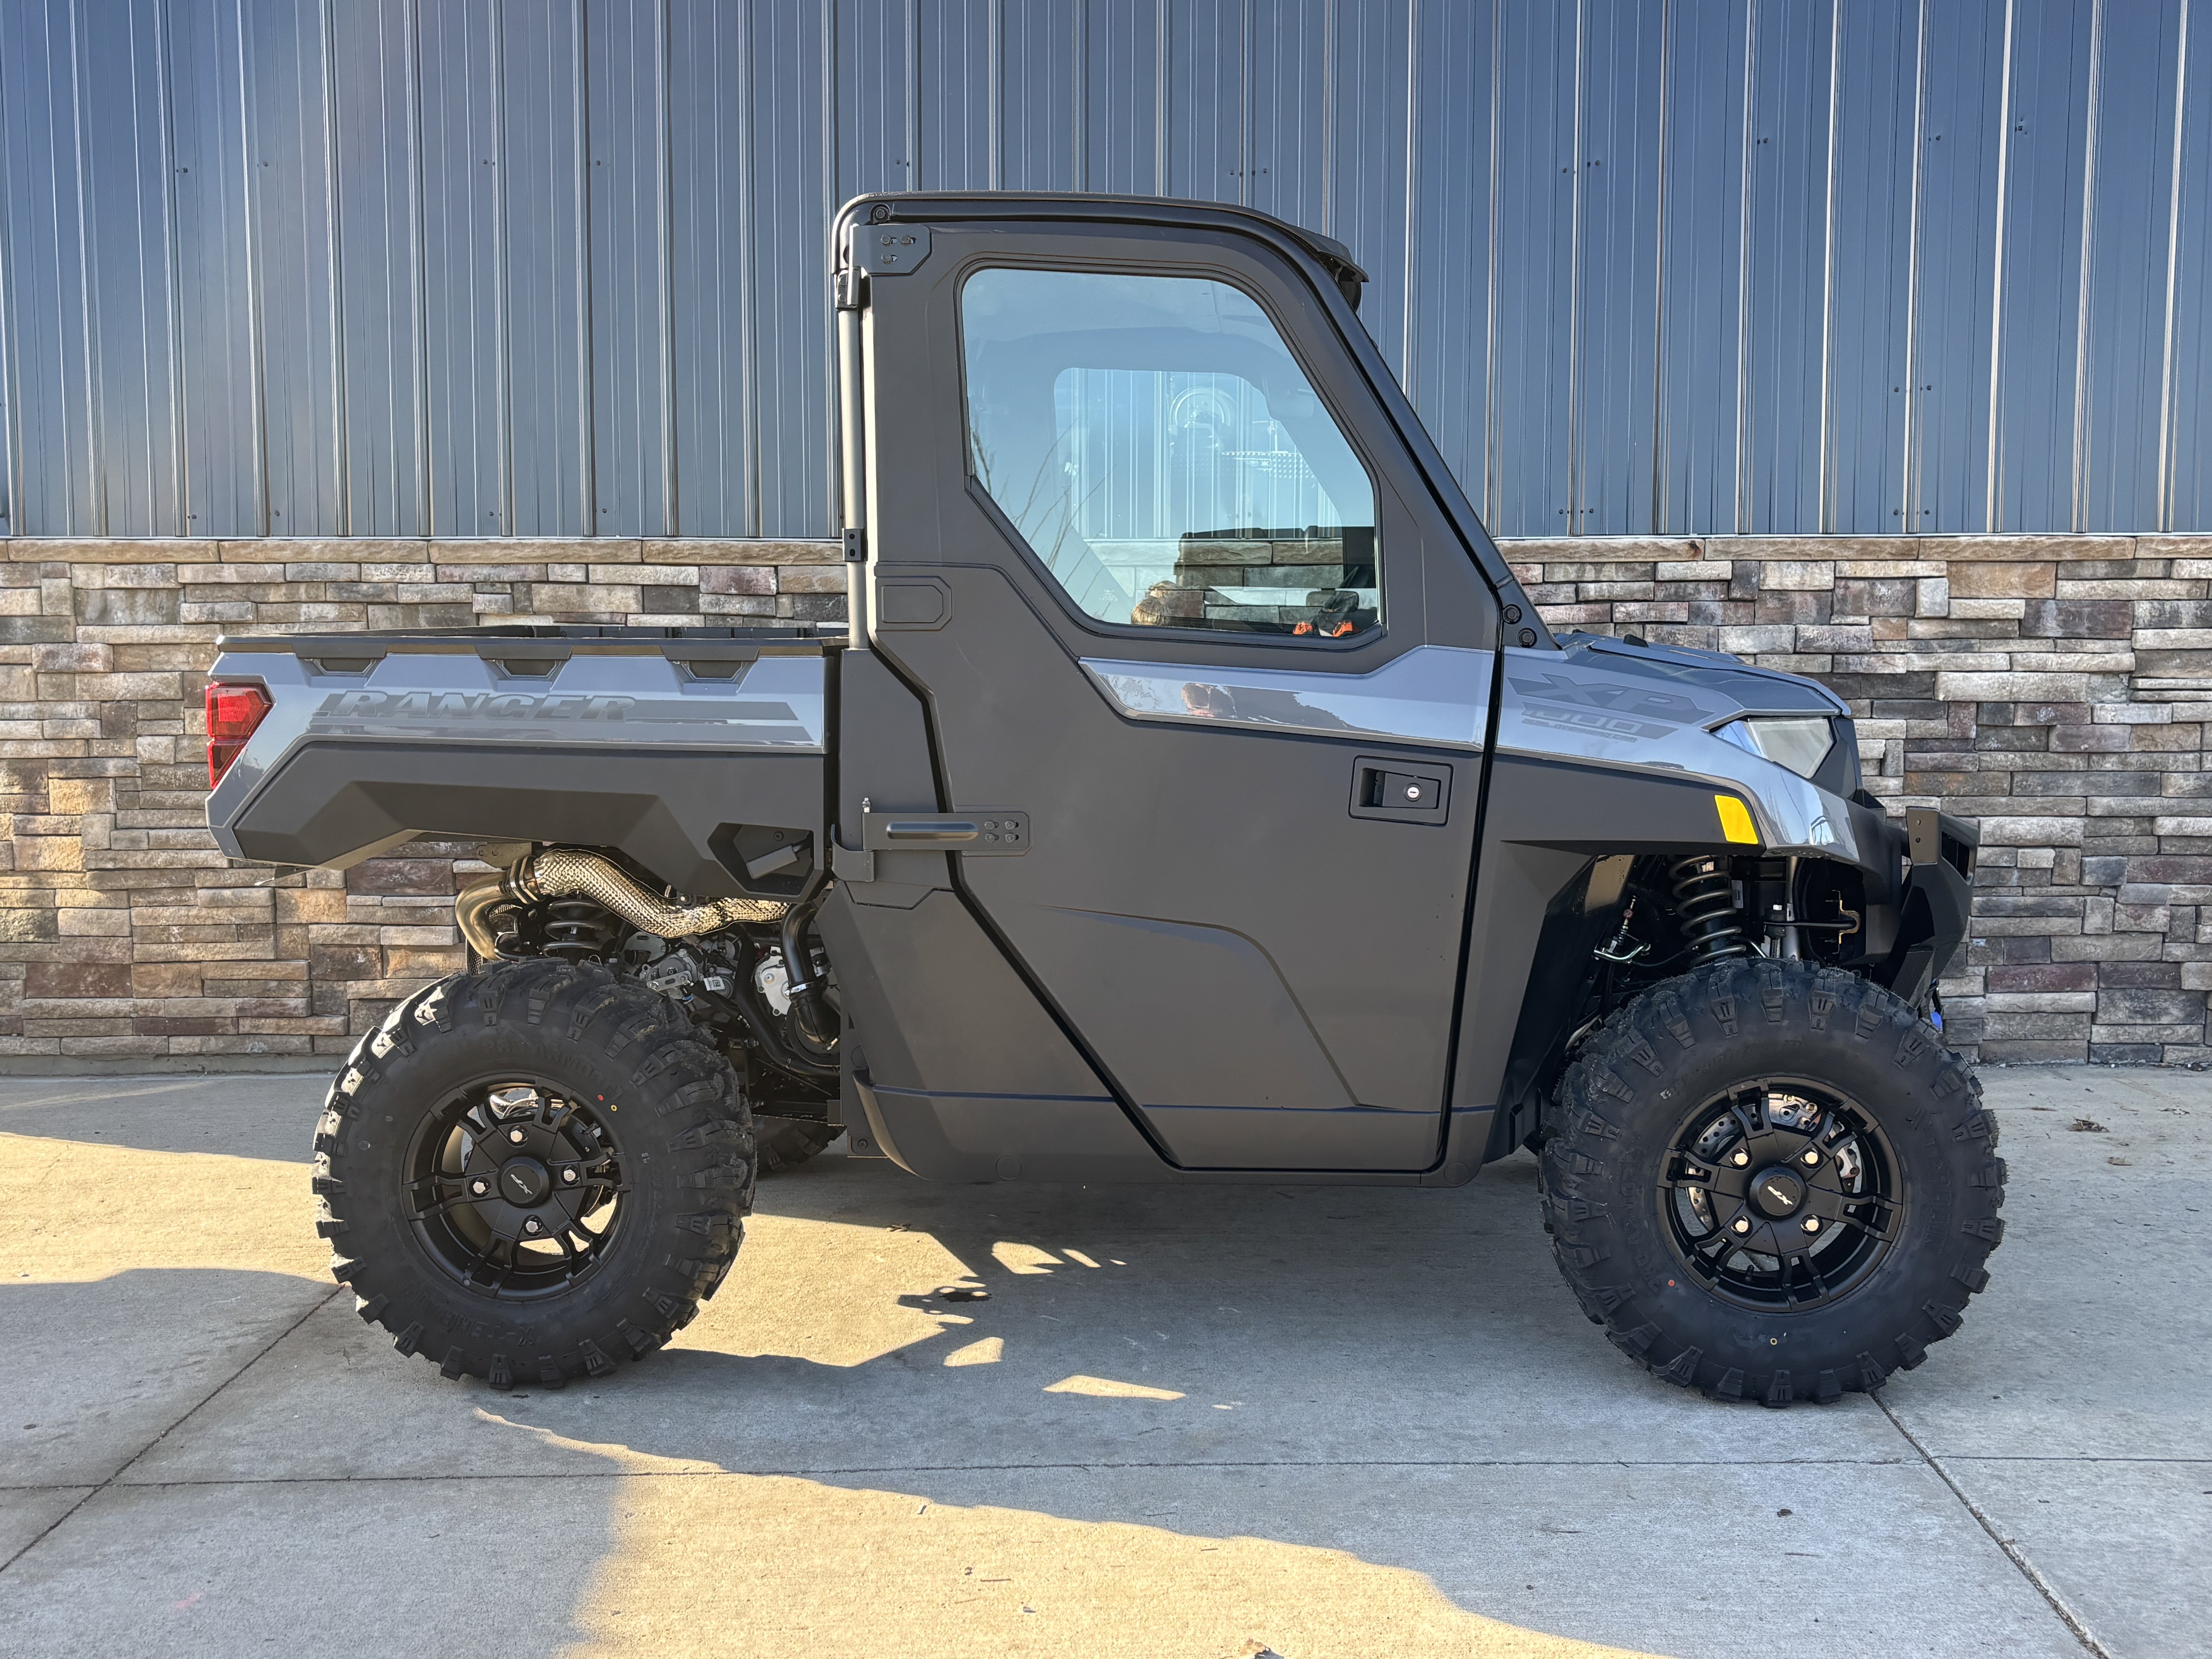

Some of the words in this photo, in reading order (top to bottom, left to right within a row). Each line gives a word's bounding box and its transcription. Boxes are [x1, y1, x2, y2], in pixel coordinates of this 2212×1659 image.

[330, 690, 636, 722] RANGER
[1508, 673, 1716, 725] XP
[510, 1174, 532, 1194] XP
[1767, 1186, 1793, 1205] XP
